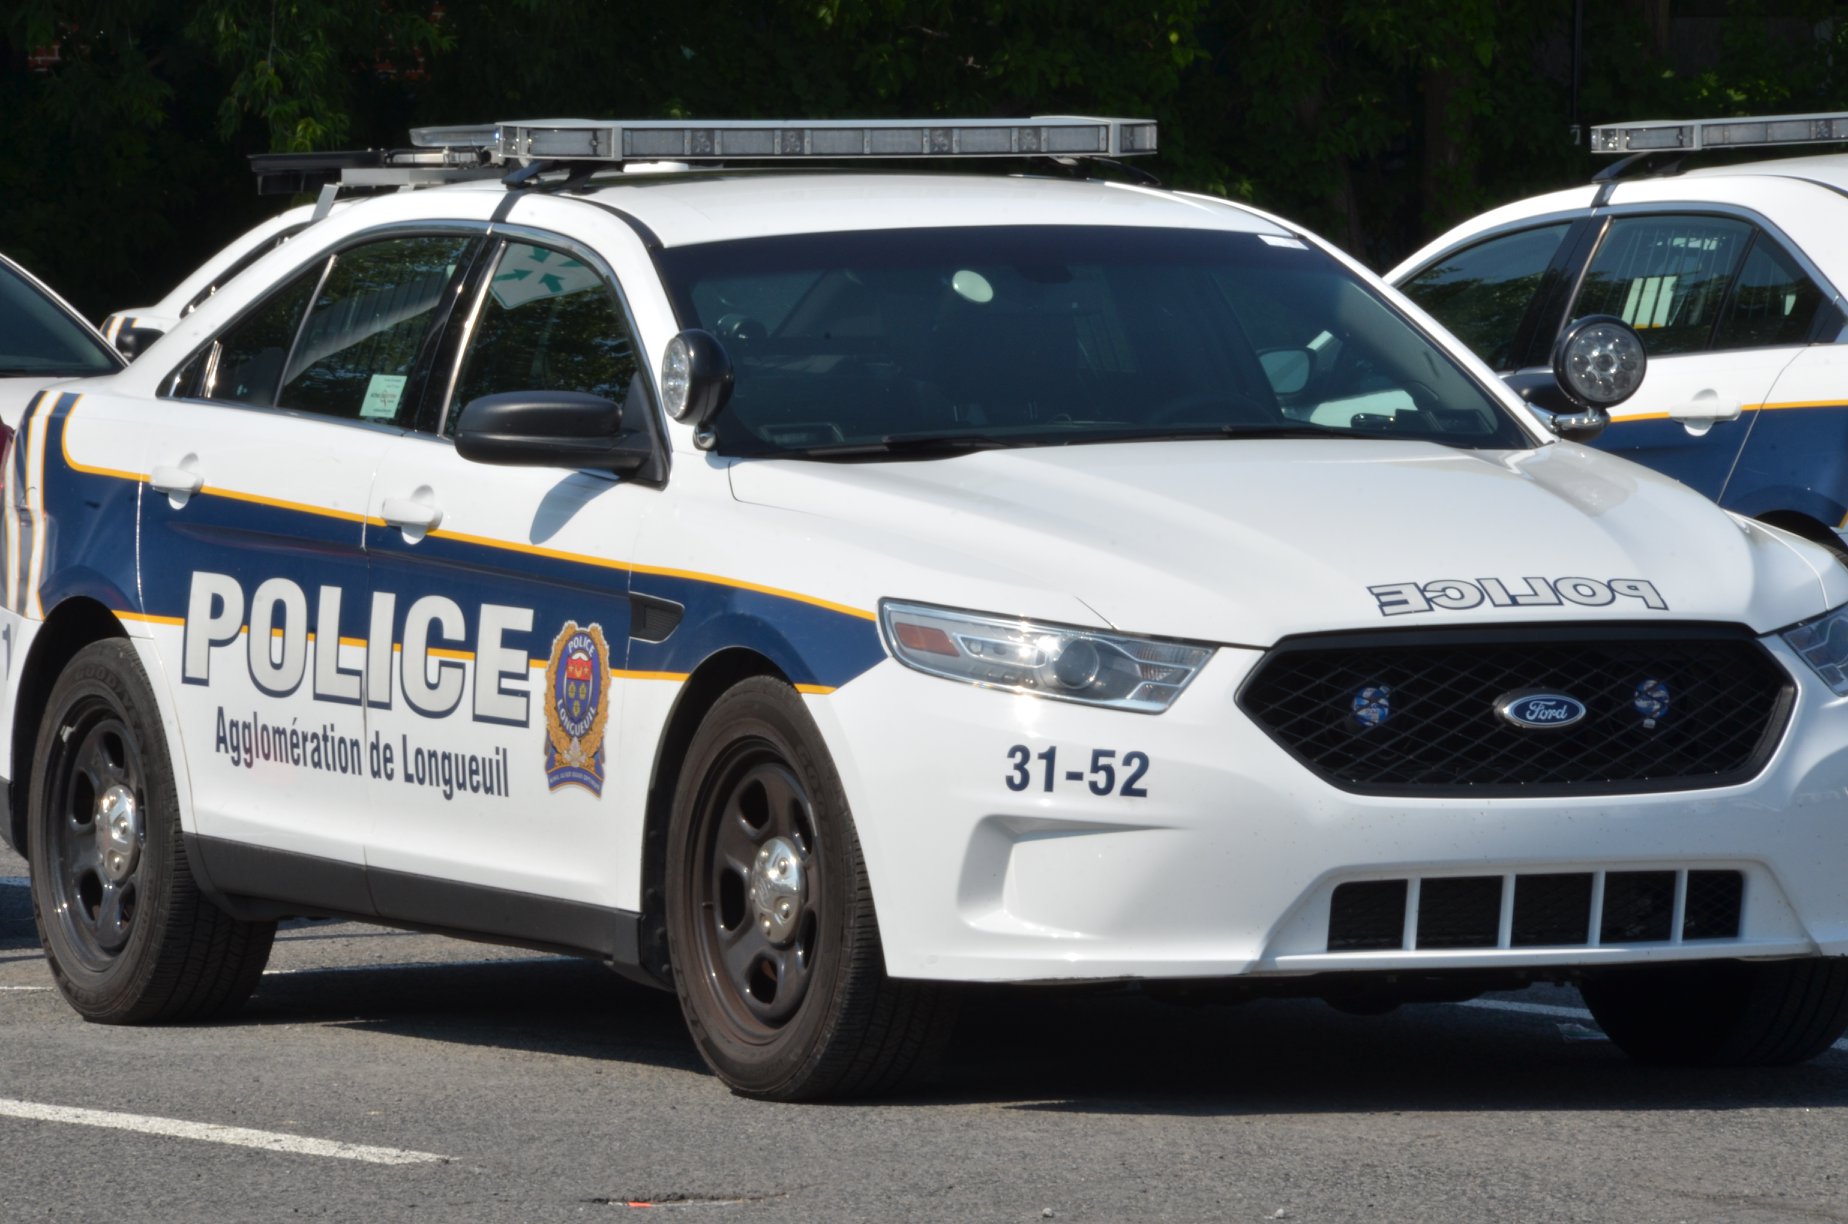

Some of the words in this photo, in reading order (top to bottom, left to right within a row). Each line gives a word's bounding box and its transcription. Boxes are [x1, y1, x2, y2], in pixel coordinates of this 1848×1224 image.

[182, 571, 535, 728] POLICE
[567, 636, 595, 658] POLICE
[556, 698, 598, 738] LONGUEUIL
[1526, 701, 1568, 720] Ford
[215, 706, 362, 776] Agglomération
[369, 731, 395, 781] de
[402, 734, 509, 801] Longueuil
[1005, 744, 1150, 798] 31-52
